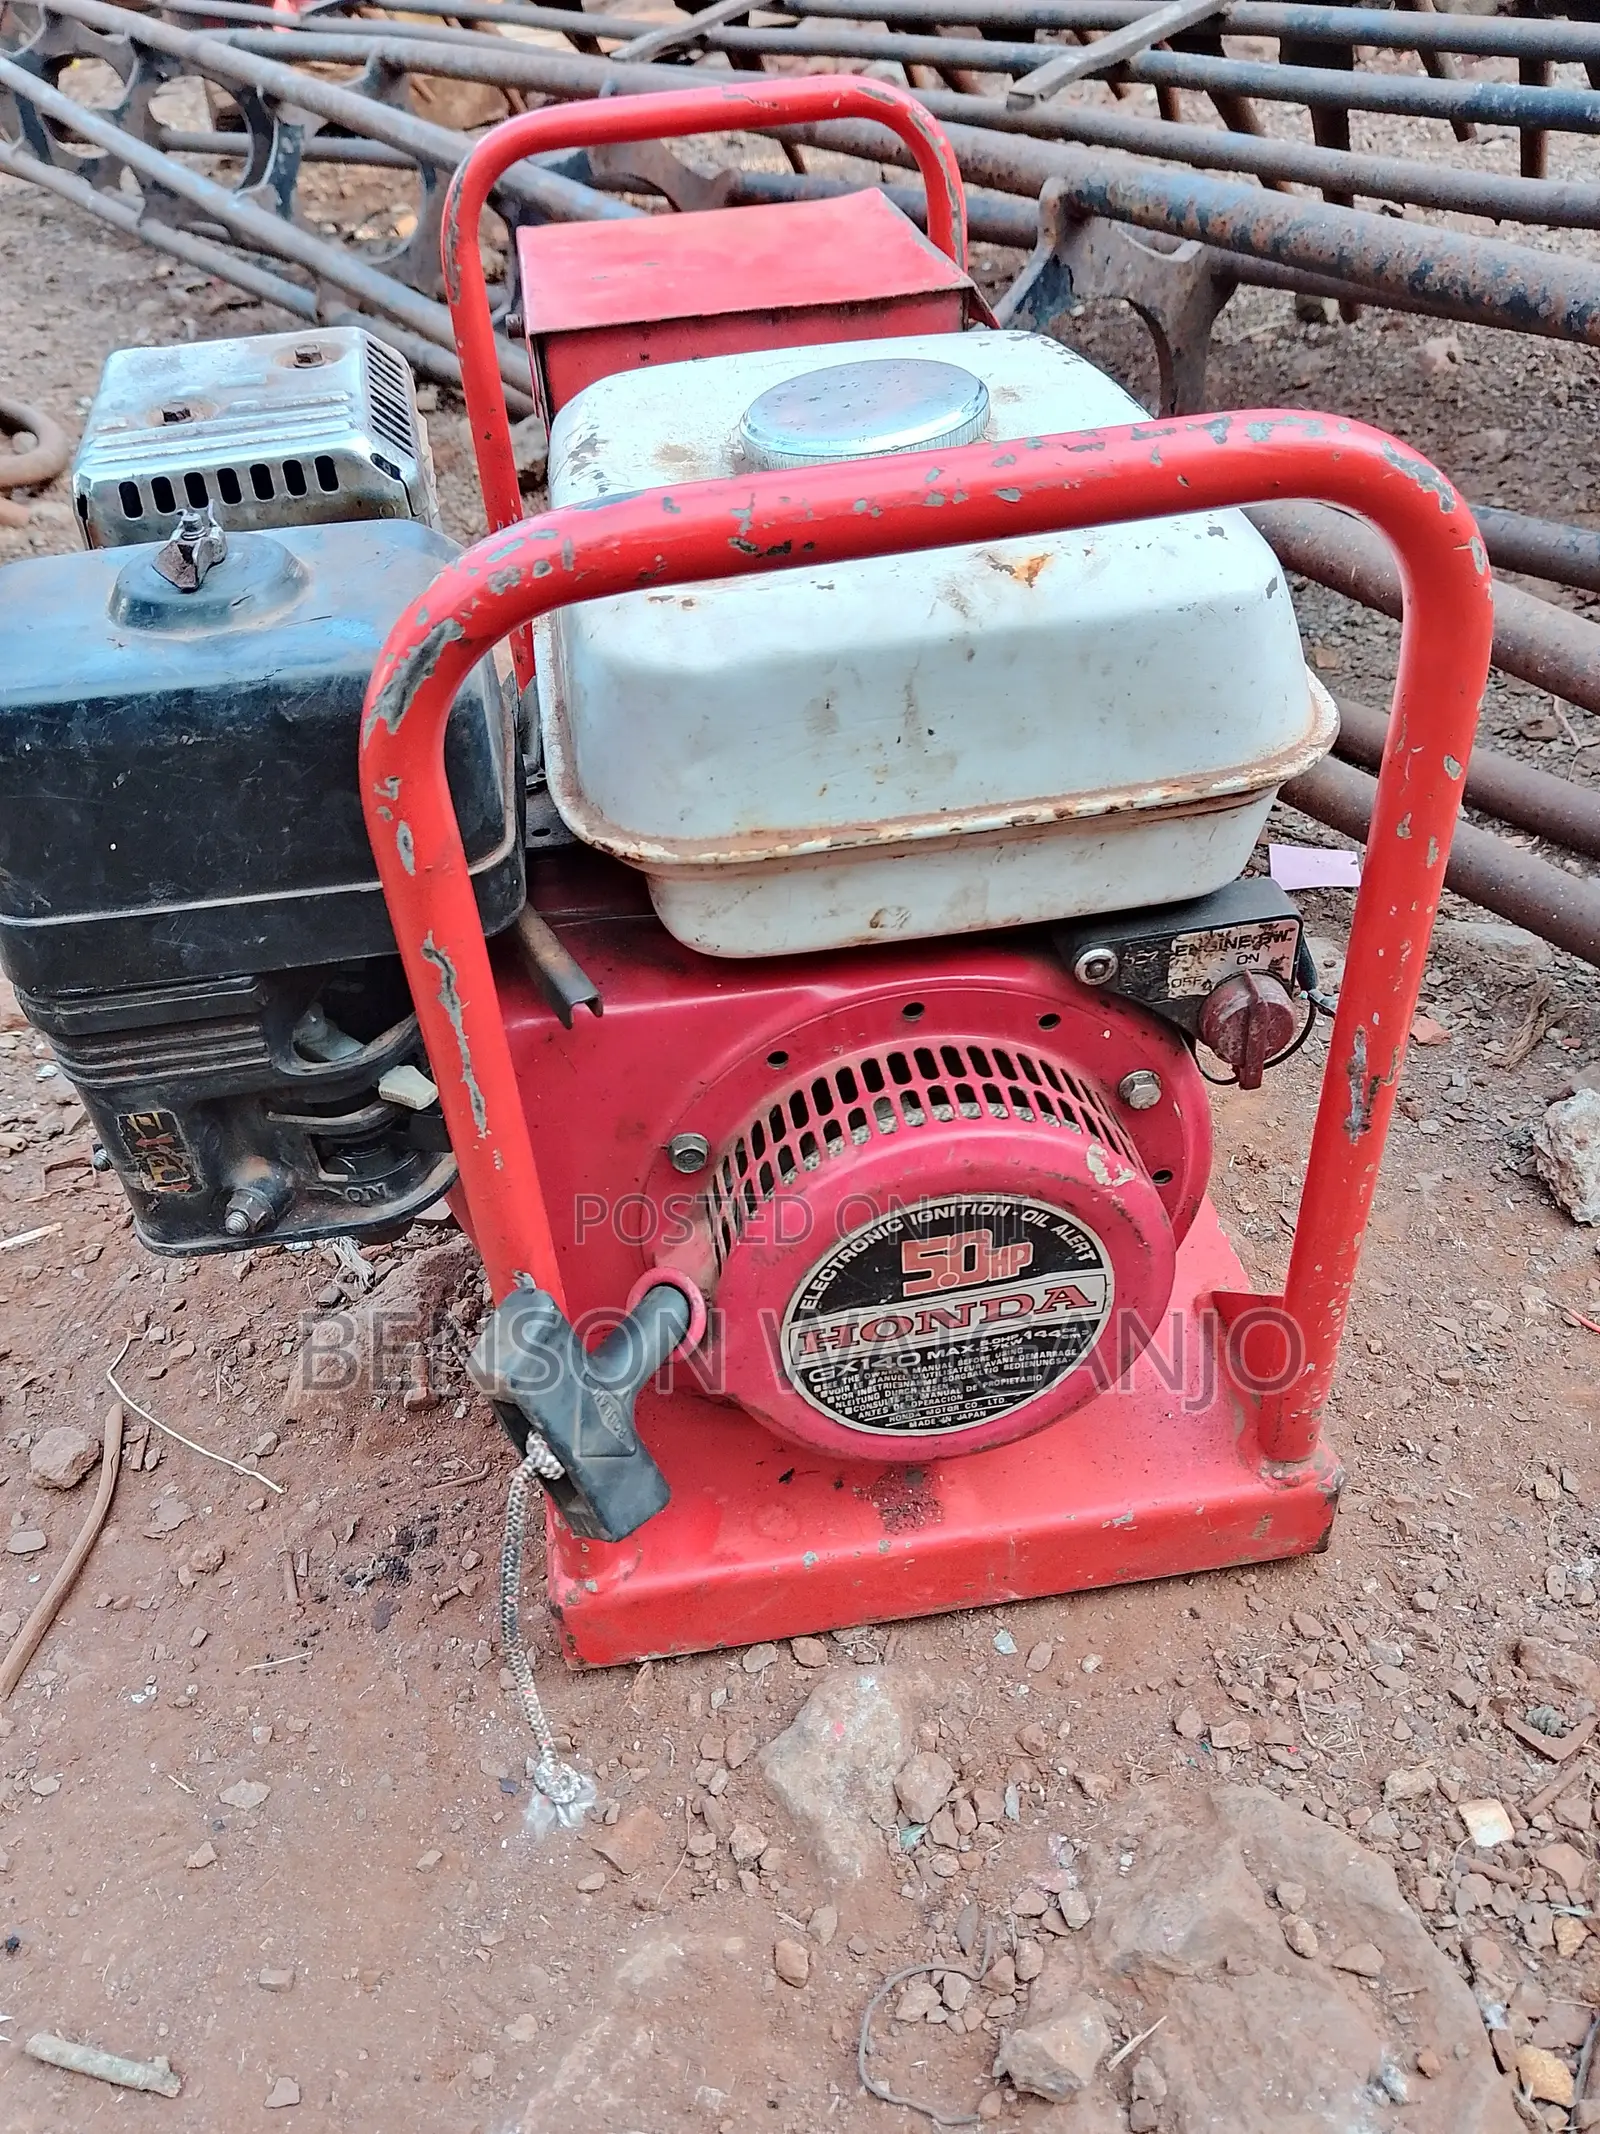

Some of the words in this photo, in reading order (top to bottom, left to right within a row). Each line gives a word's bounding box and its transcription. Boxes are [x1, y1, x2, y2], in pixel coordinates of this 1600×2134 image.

[1236, 953, 1260, 966] ON
[799, 1218, 905, 1311] ELECTRONIC
[909, 1203, 1011, 1226] IGNITION
[1020, 1209, 1051, 1228] OIL
[1050, 1223, 1098, 1262] ALERT
[798, 1284, 1097, 1356] HONDA
[809, 1353, 921, 1383] GX140
[822, 1380, 838, 1390] SEE
[841, 1374, 860, 1385] THE
[912, 1361, 954, 1374] MANUAL
[957, 1354, 991, 1366] BEFORE
[994, 1346, 1024, 1359] USING
[828, 1384, 851, 1396] VOIR
[853, 1381, 864, 1391] LE
[984, 1355, 1016, 1369] AVANT
[1018, 1348, 1078, 1362] DEMARRAGE
[835, 1391, 854, 1401] VOR
[884, 1387, 918, 1398] DURCH
[921, 1383, 949, 1393] LESEN
[920, 1388, 962, 1400] MANUAL
[965, 1383, 978, 1393] DE
[982, 1373, 1043, 1389] PROPIETARIO
[858, 1406, 889, 1420] ANTES
[910, 1394, 964, 1408] OPERACION
[888, 1411, 922, 1423] HONDA
[925, 1404, 960, 1416] MOTOR
[908, 1418, 936, 1428] MADE
[956, 1410, 988, 1421] JAPAN
